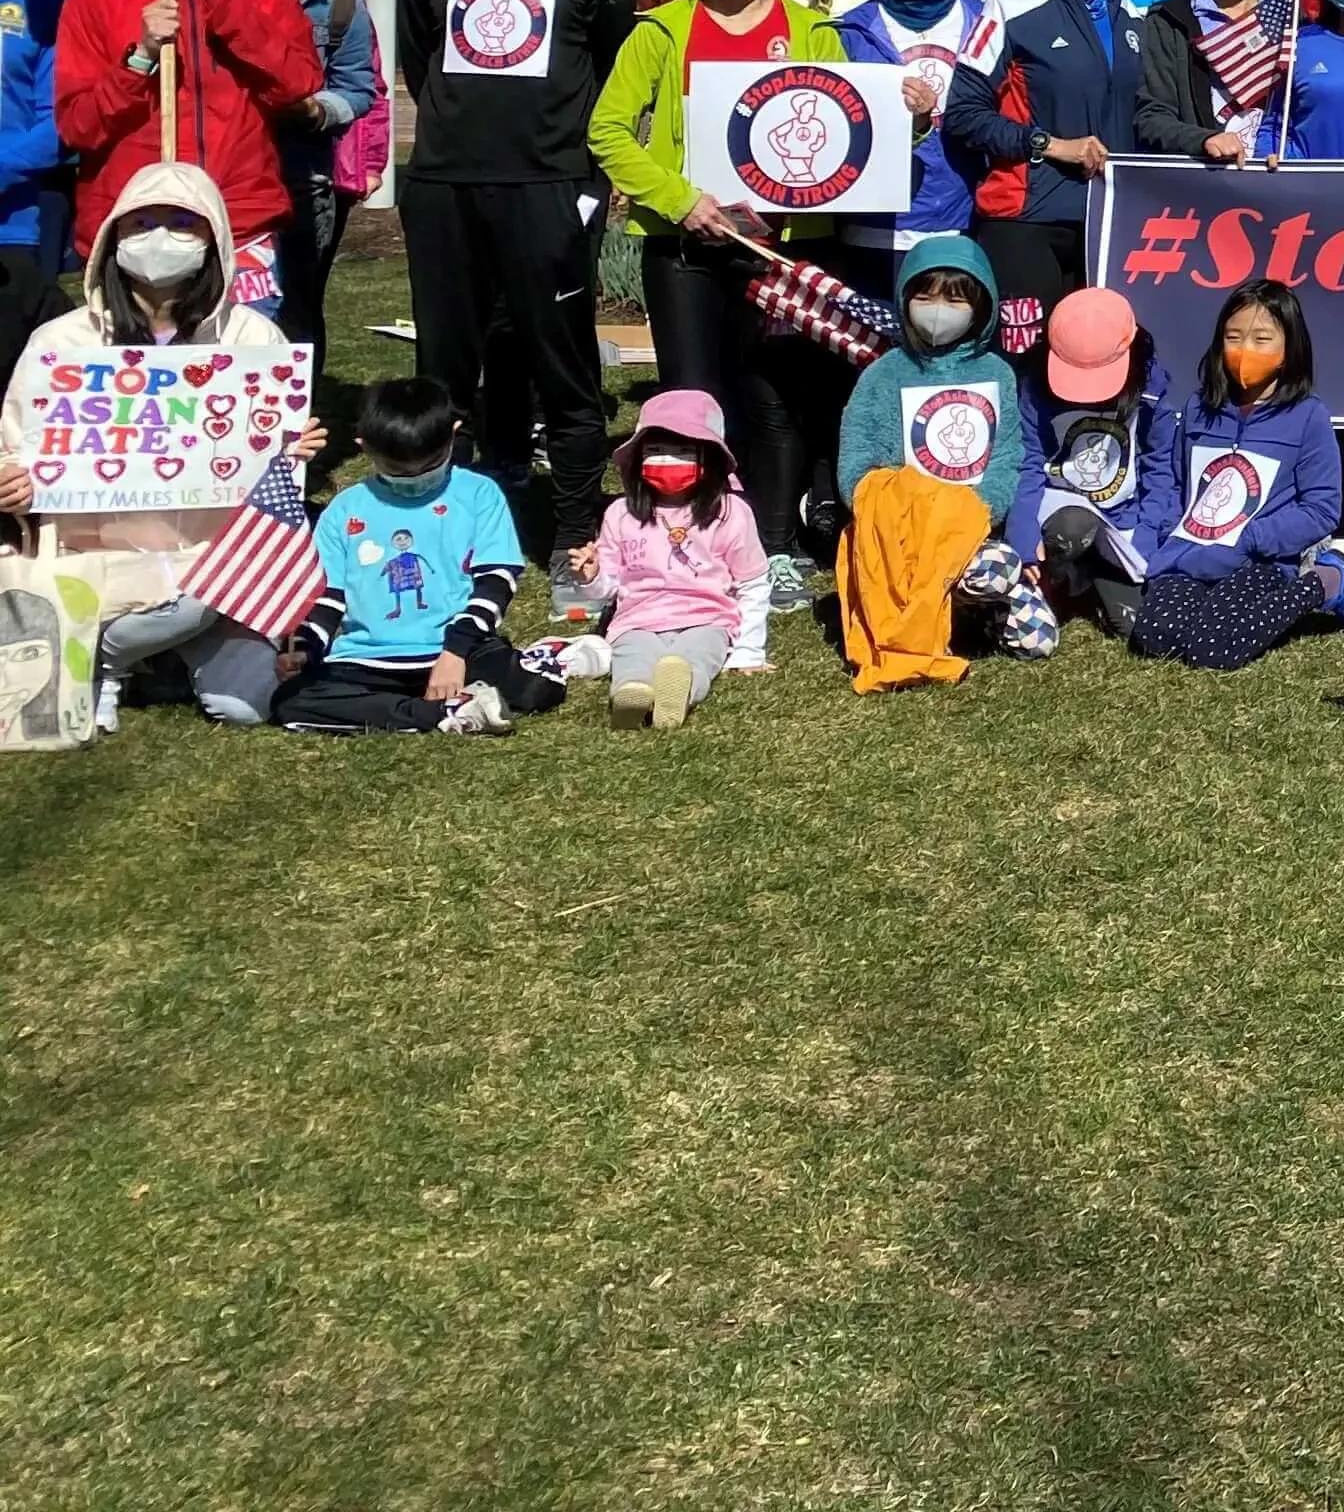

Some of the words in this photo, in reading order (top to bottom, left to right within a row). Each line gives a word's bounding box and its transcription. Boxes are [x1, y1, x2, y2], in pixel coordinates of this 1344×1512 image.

[736, 69, 865, 123] #StopAsianHate
[736, 162, 787, 203] ASIAN
[792, 163, 860, 206] STRONG
[1001, 297, 1042, 324] STOP
[50, 364, 178, 395] STOP
[44, 396, 199, 425] ASIAN
[40, 426, 172, 456] HATE
[110, 488, 172, 508] MAKES
[181, 489, 201, 505] US
[210, 487, 248, 504] STR
